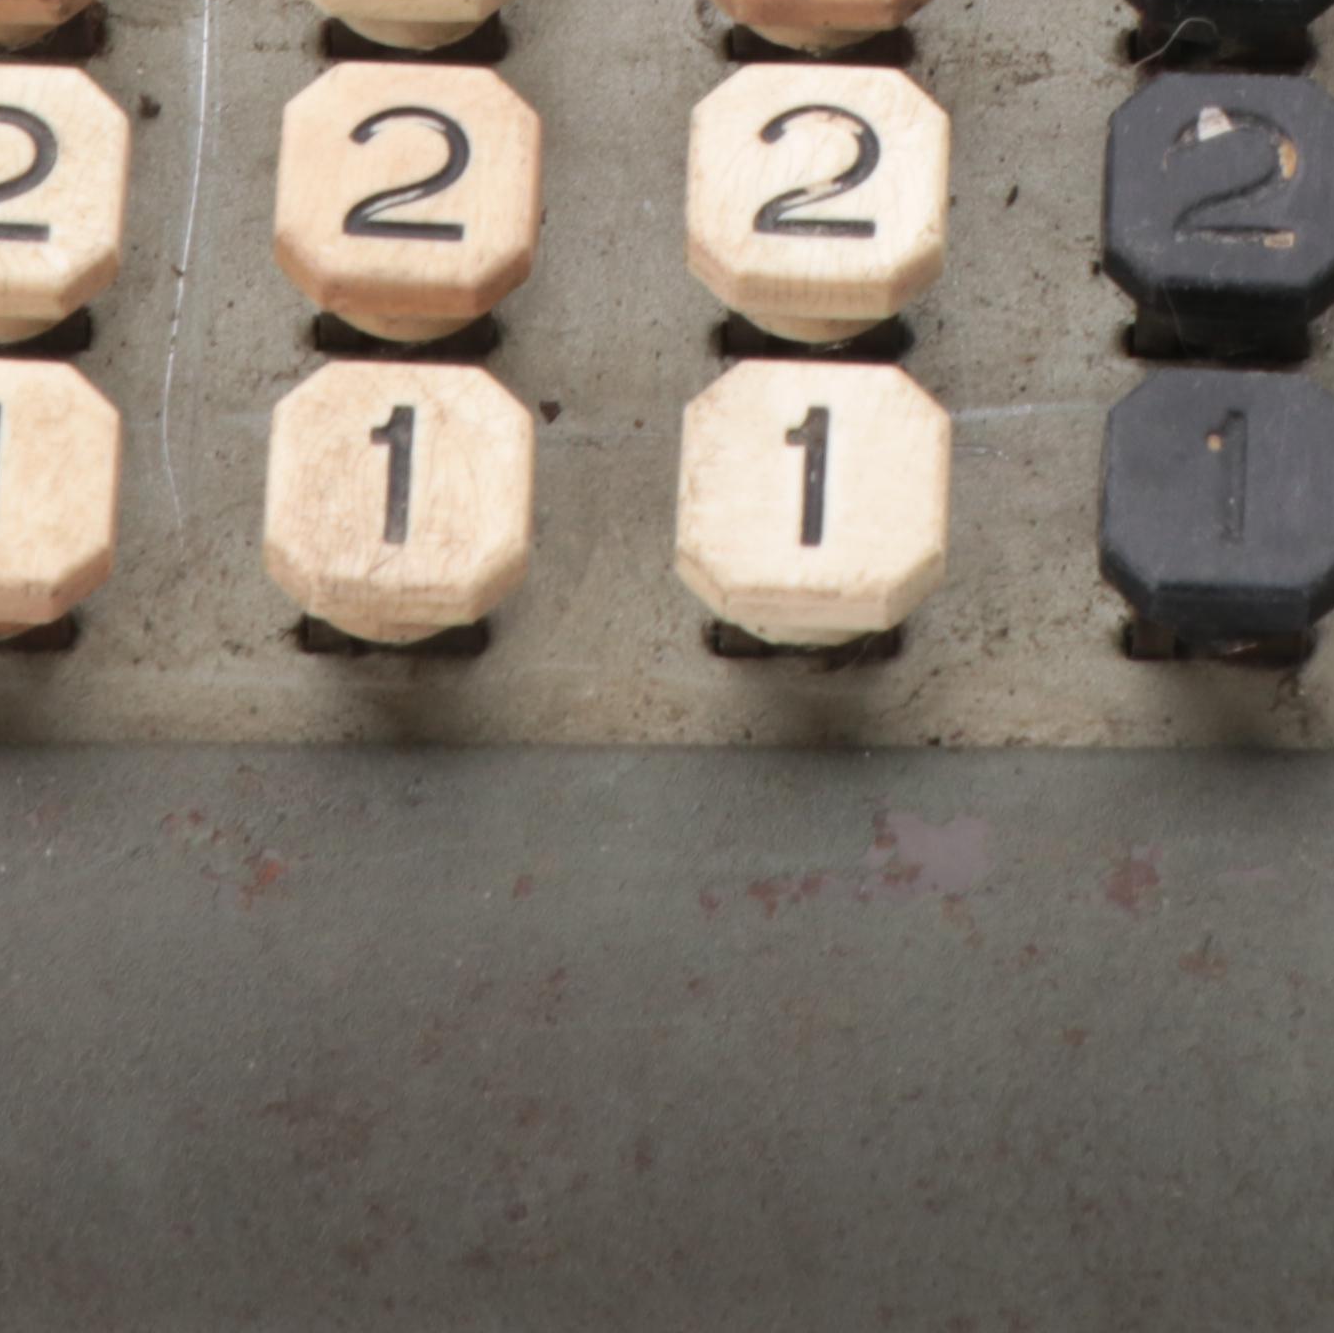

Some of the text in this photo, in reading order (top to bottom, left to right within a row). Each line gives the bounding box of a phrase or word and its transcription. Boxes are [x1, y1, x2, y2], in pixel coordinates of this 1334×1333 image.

[342, 106, 471, 242] 2
[753, 103, 881, 239] 2
[1163, 106, 1299, 248] 2
[369, 404, 417, 546] 1
[783, 405, 832, 547] 1
[1207, 407, 1248, 542] 1
